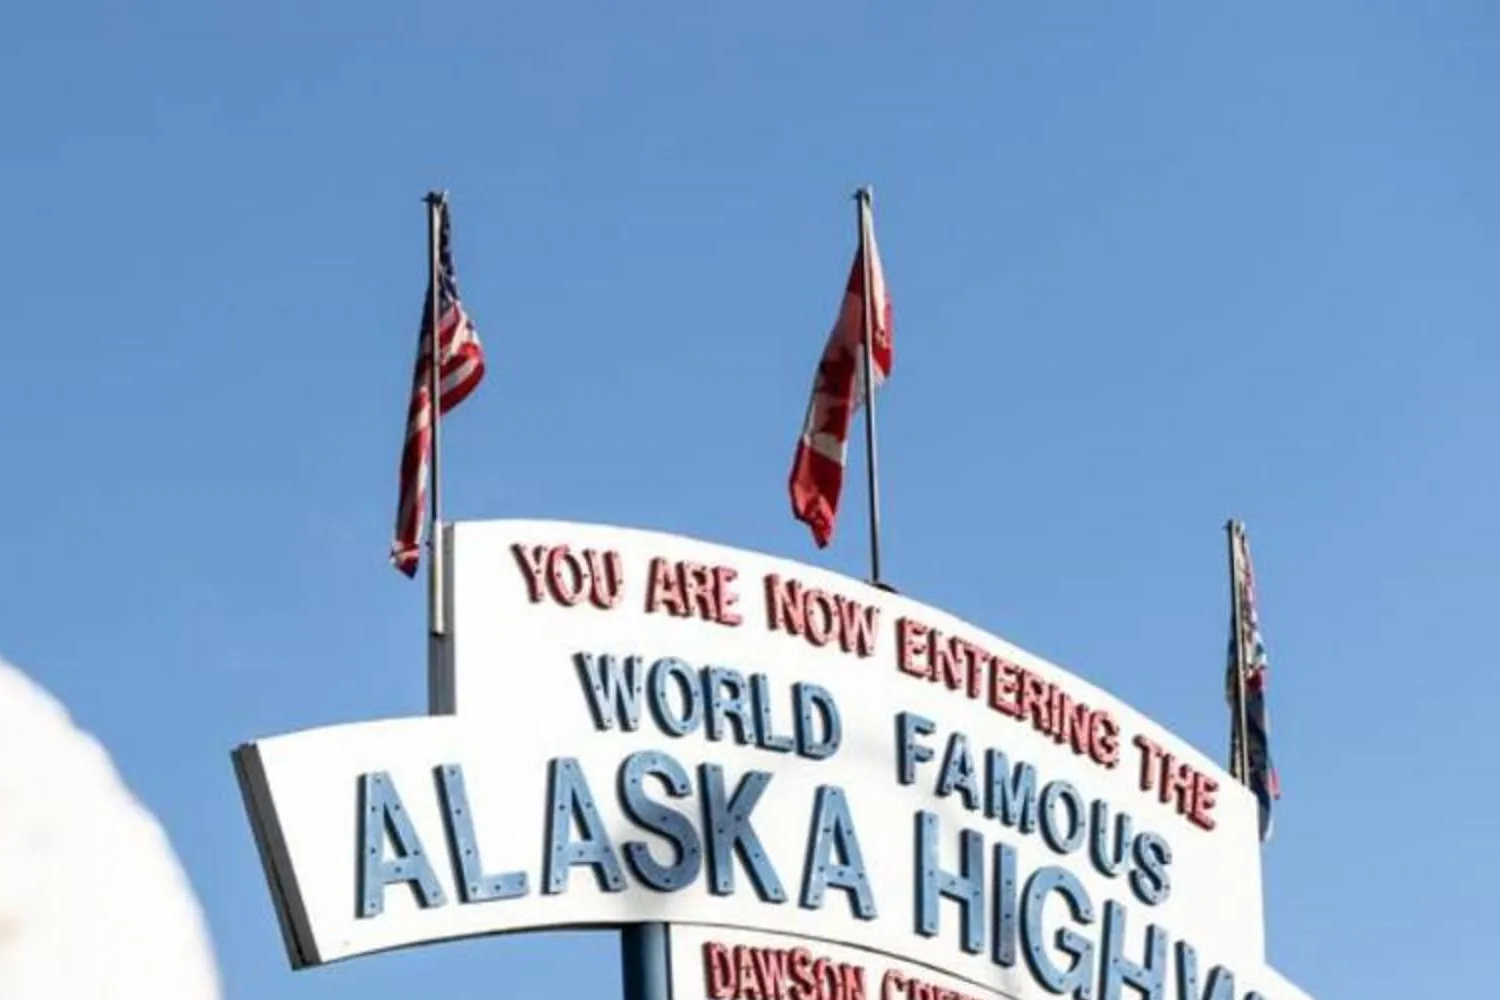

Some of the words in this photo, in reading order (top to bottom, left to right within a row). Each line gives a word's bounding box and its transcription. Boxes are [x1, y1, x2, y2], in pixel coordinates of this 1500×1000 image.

[510, 543, 623, 610] YOU
[645, 557, 742, 627] ARE
[763, 573, 880, 657] NOW
[895, 616, 1122, 769] ENTERING
[1132, 734, 1219, 830] THE
[571, 651, 843, 759] WORLD
[895, 710, 1172, 904] FAMOUS
[354, 750, 878, 921] ALASKA
